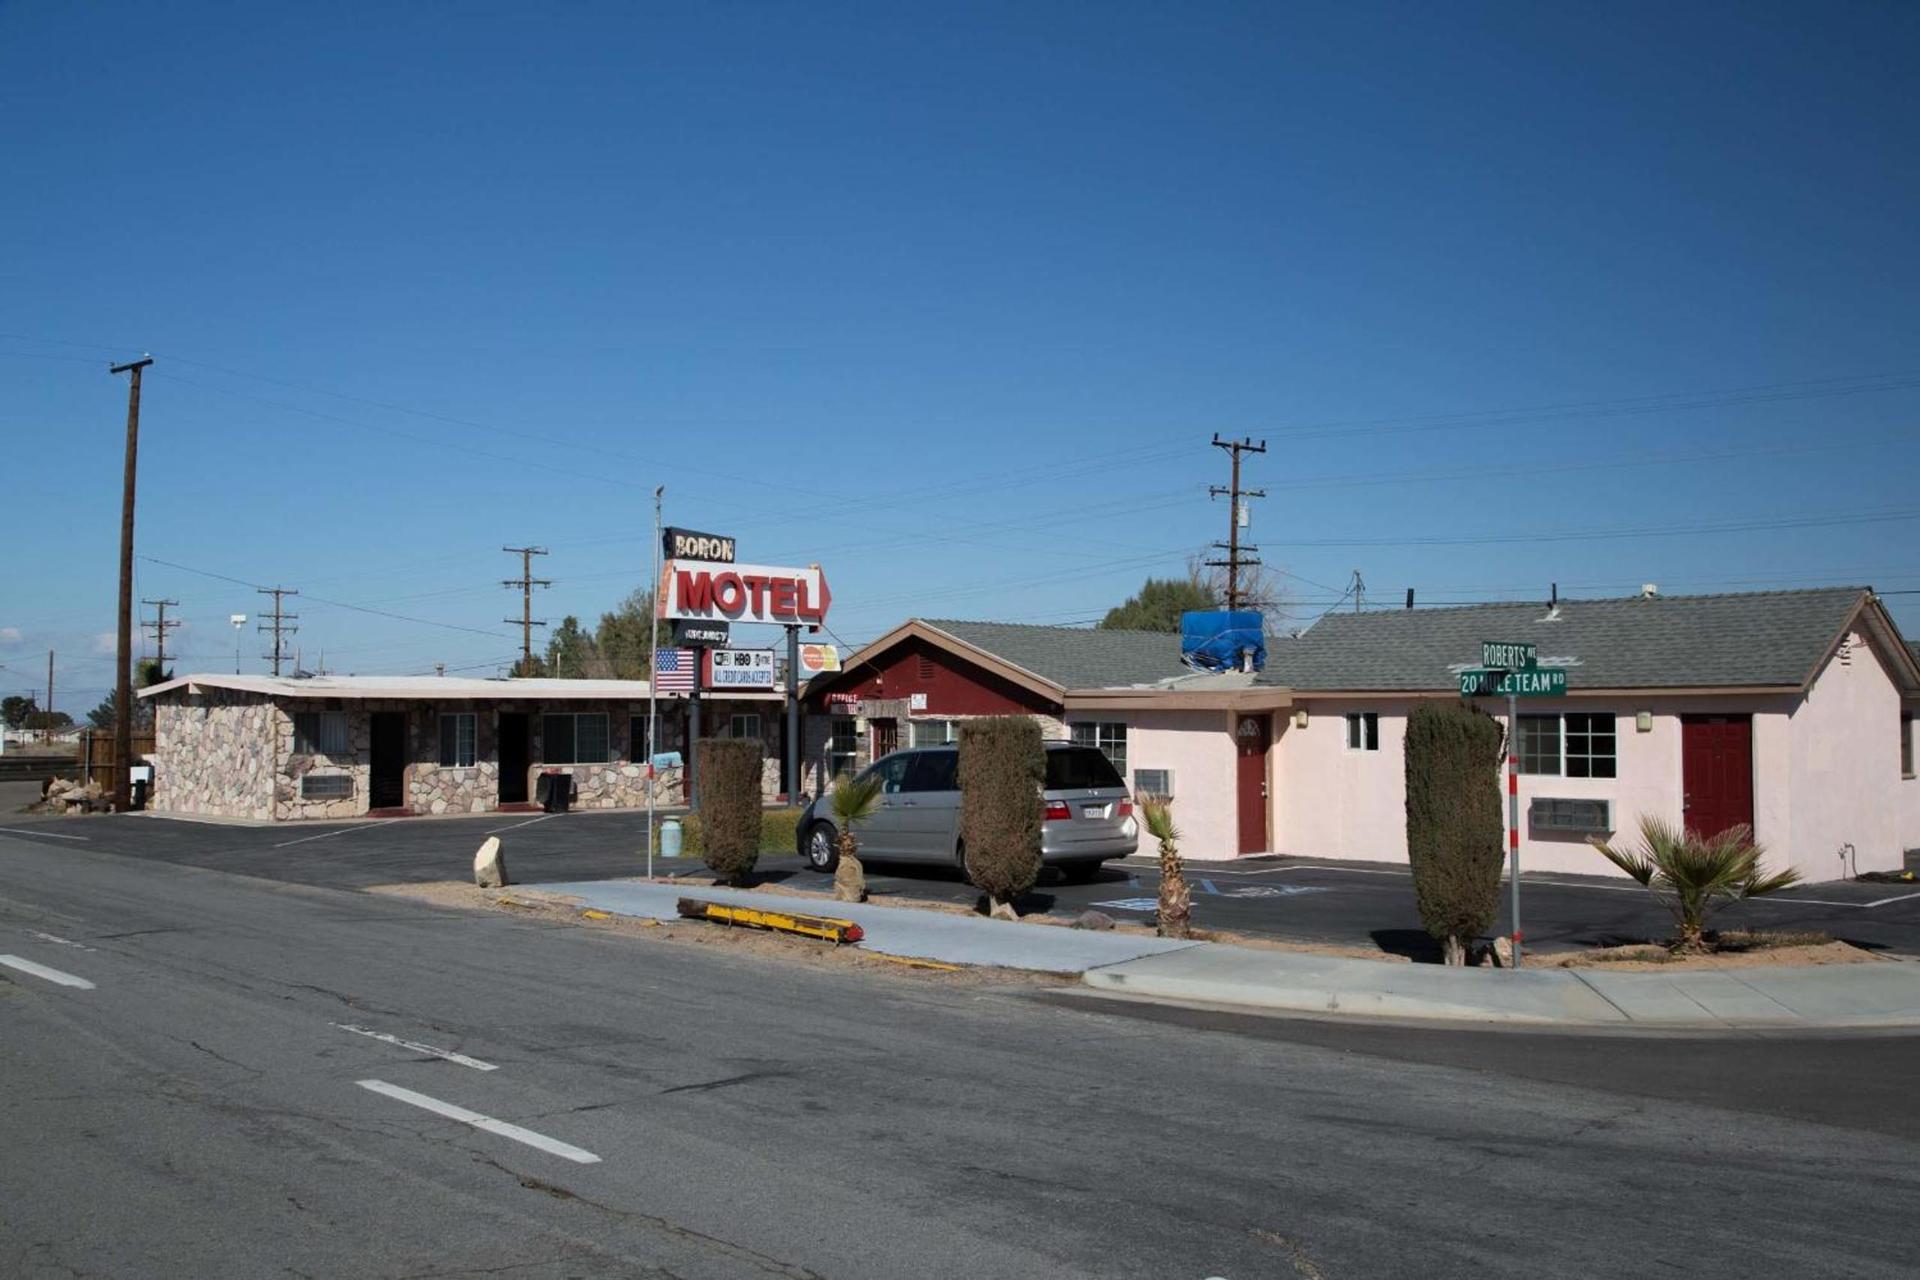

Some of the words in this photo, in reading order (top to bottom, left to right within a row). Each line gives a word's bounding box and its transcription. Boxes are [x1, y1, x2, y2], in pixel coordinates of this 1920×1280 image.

[675, 535, 733, 561] BORON
[676, 570, 822, 620] MOTEL
[734, 652, 751, 666] HBO
[1483, 644, 1525, 667] ROBERTS
[1527, 647, 1537, 659] AVE
[1462, 675, 1477, 693] 20
[1516, 674, 1551, 692] TEAM
[1553, 674, 1565, 685] RD
